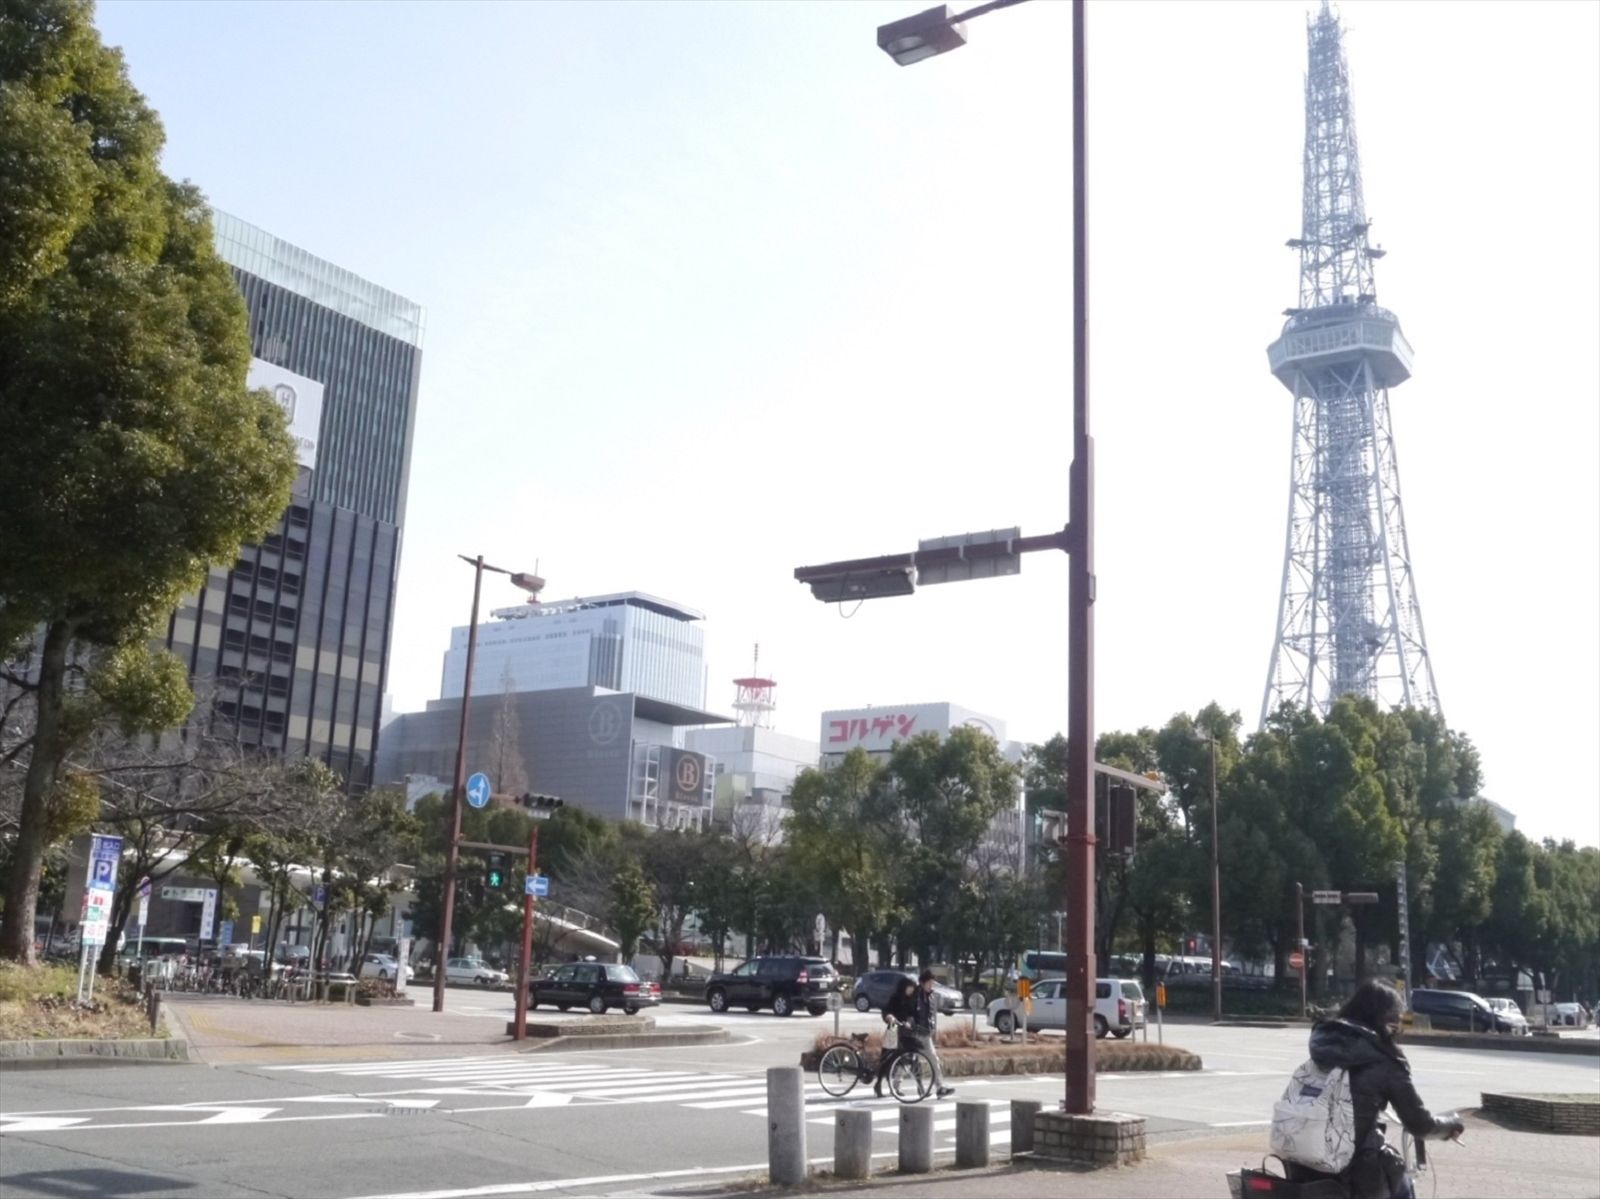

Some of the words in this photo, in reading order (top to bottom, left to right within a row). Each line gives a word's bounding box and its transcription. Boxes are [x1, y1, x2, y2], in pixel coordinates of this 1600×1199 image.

[829, 713, 918, 743] コルゲン
[95, 861, 110, 882] P
